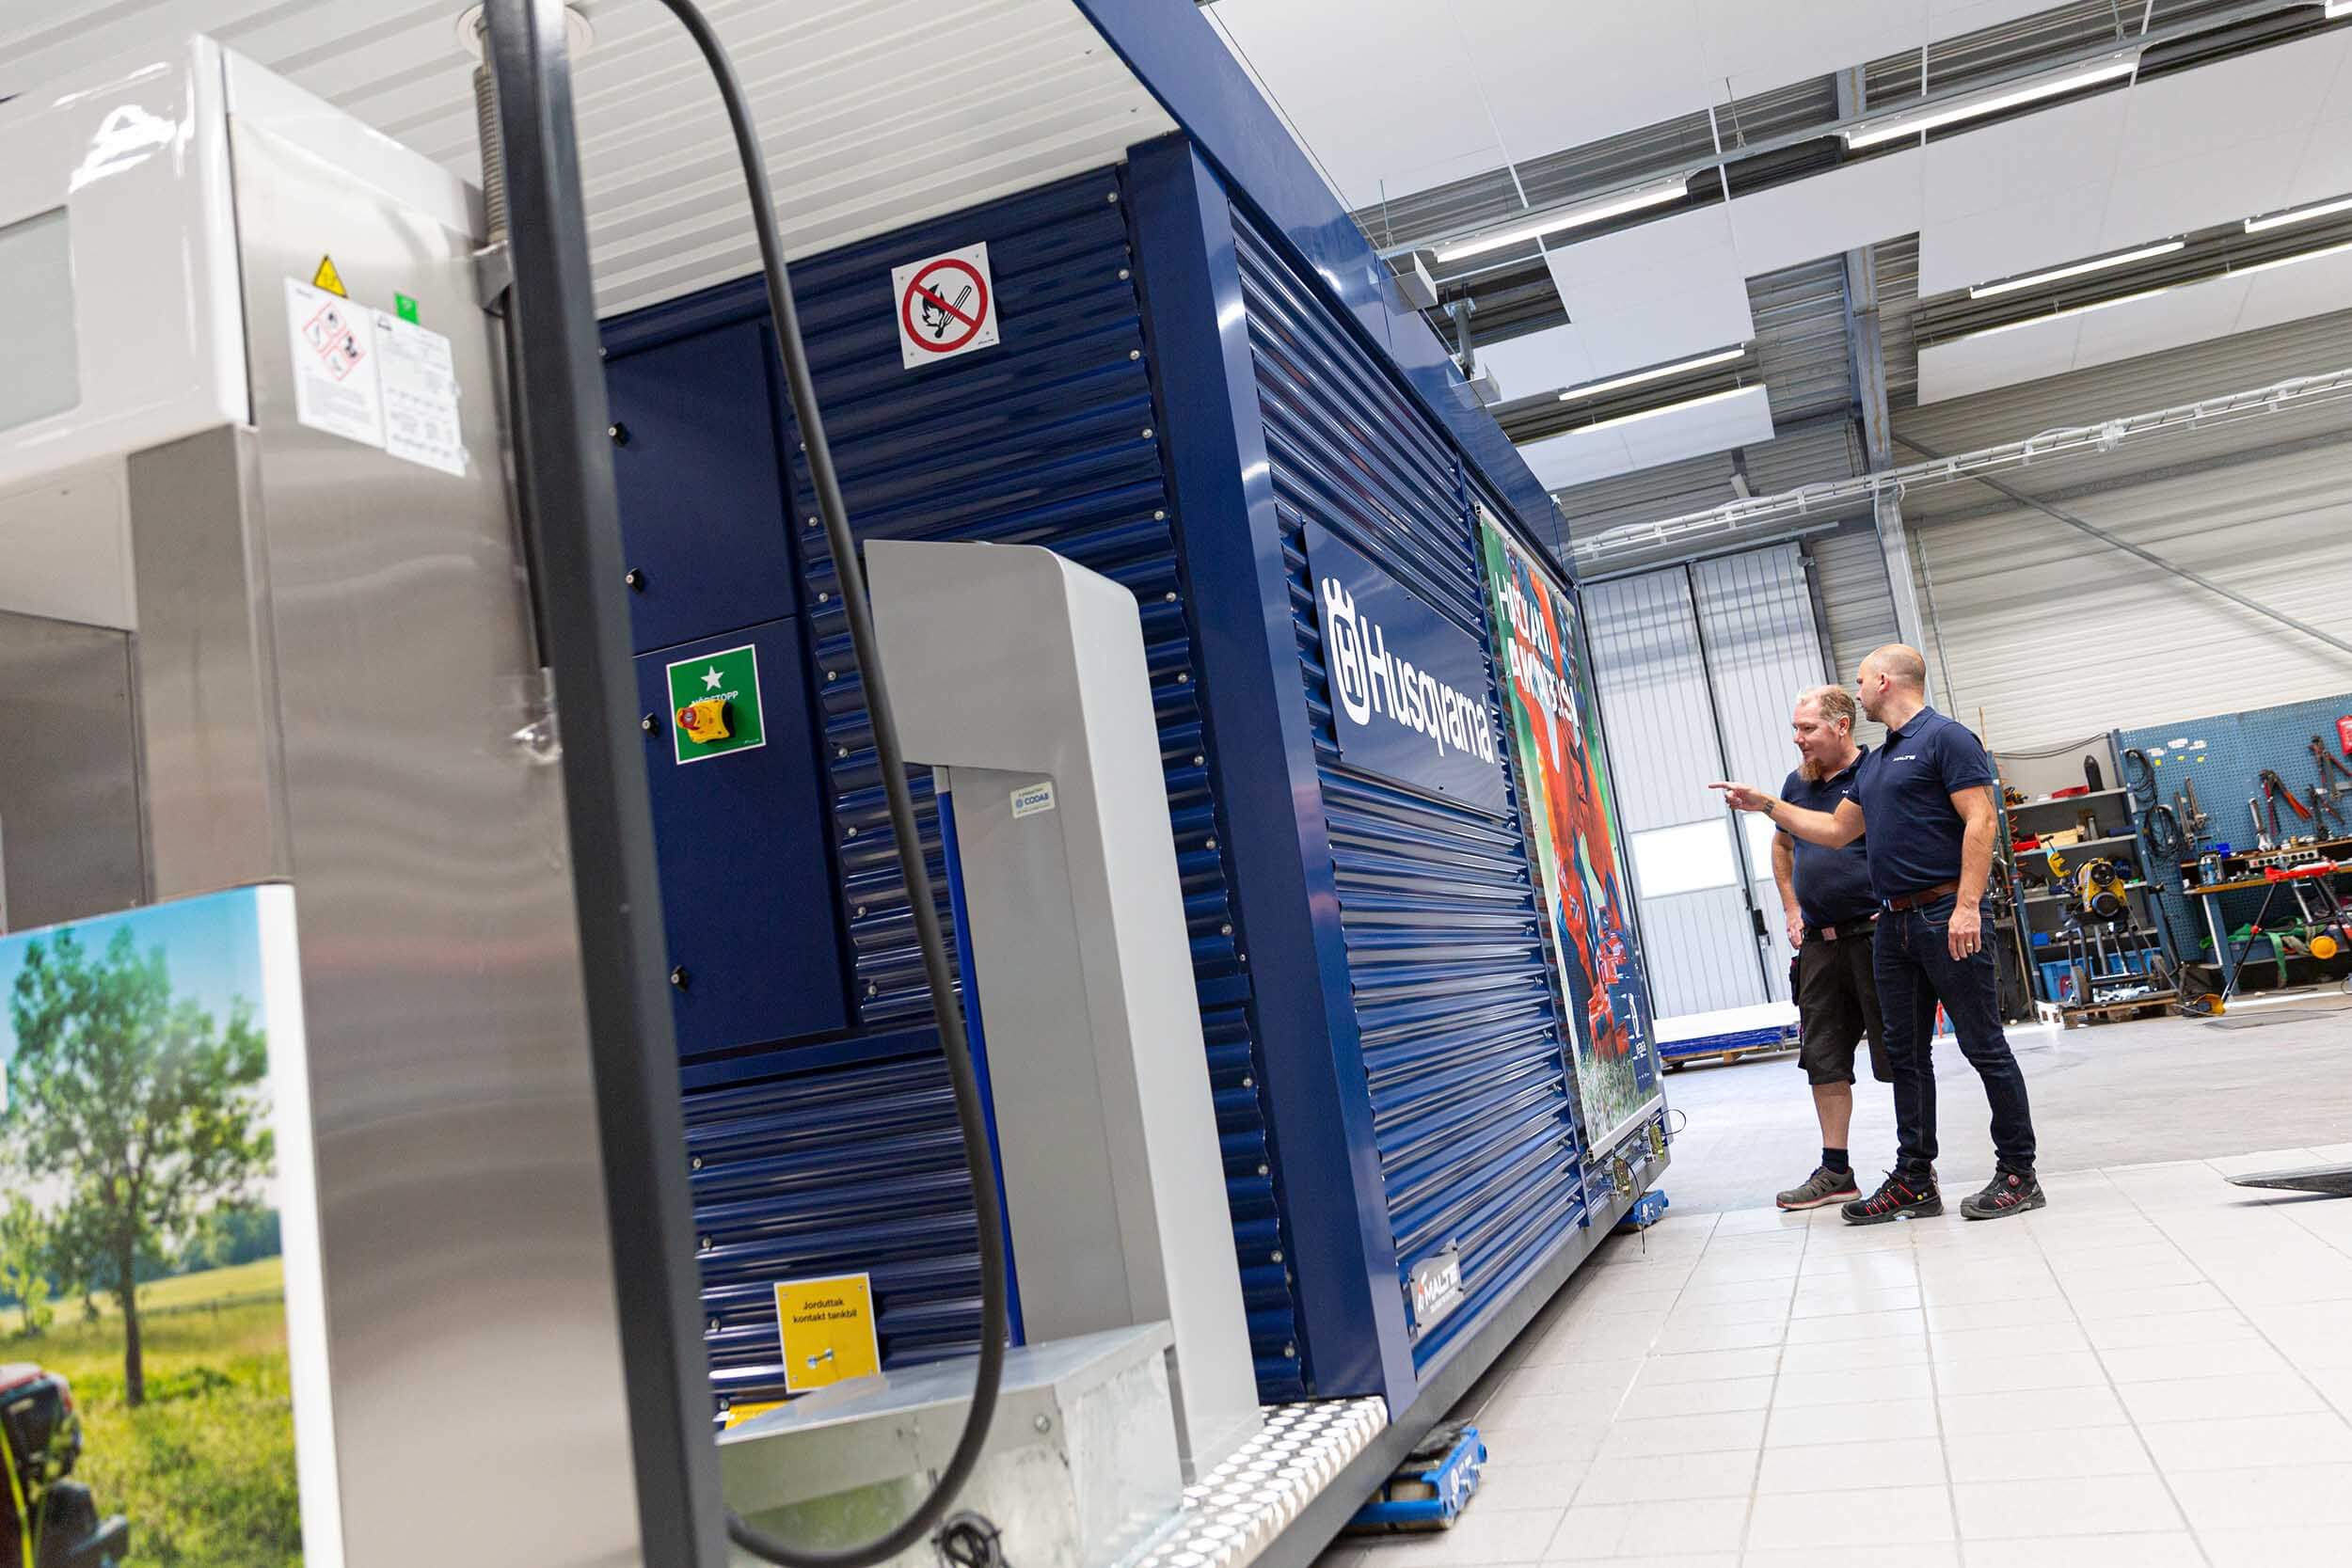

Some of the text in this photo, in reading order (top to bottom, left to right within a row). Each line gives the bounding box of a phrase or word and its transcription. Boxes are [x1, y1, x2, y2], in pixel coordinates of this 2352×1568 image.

[1360, 615, 1494, 764] Husqvarna
[804, 1298, 844, 1309] Jorduttak
[793, 1312, 825, 1323] kontakt
